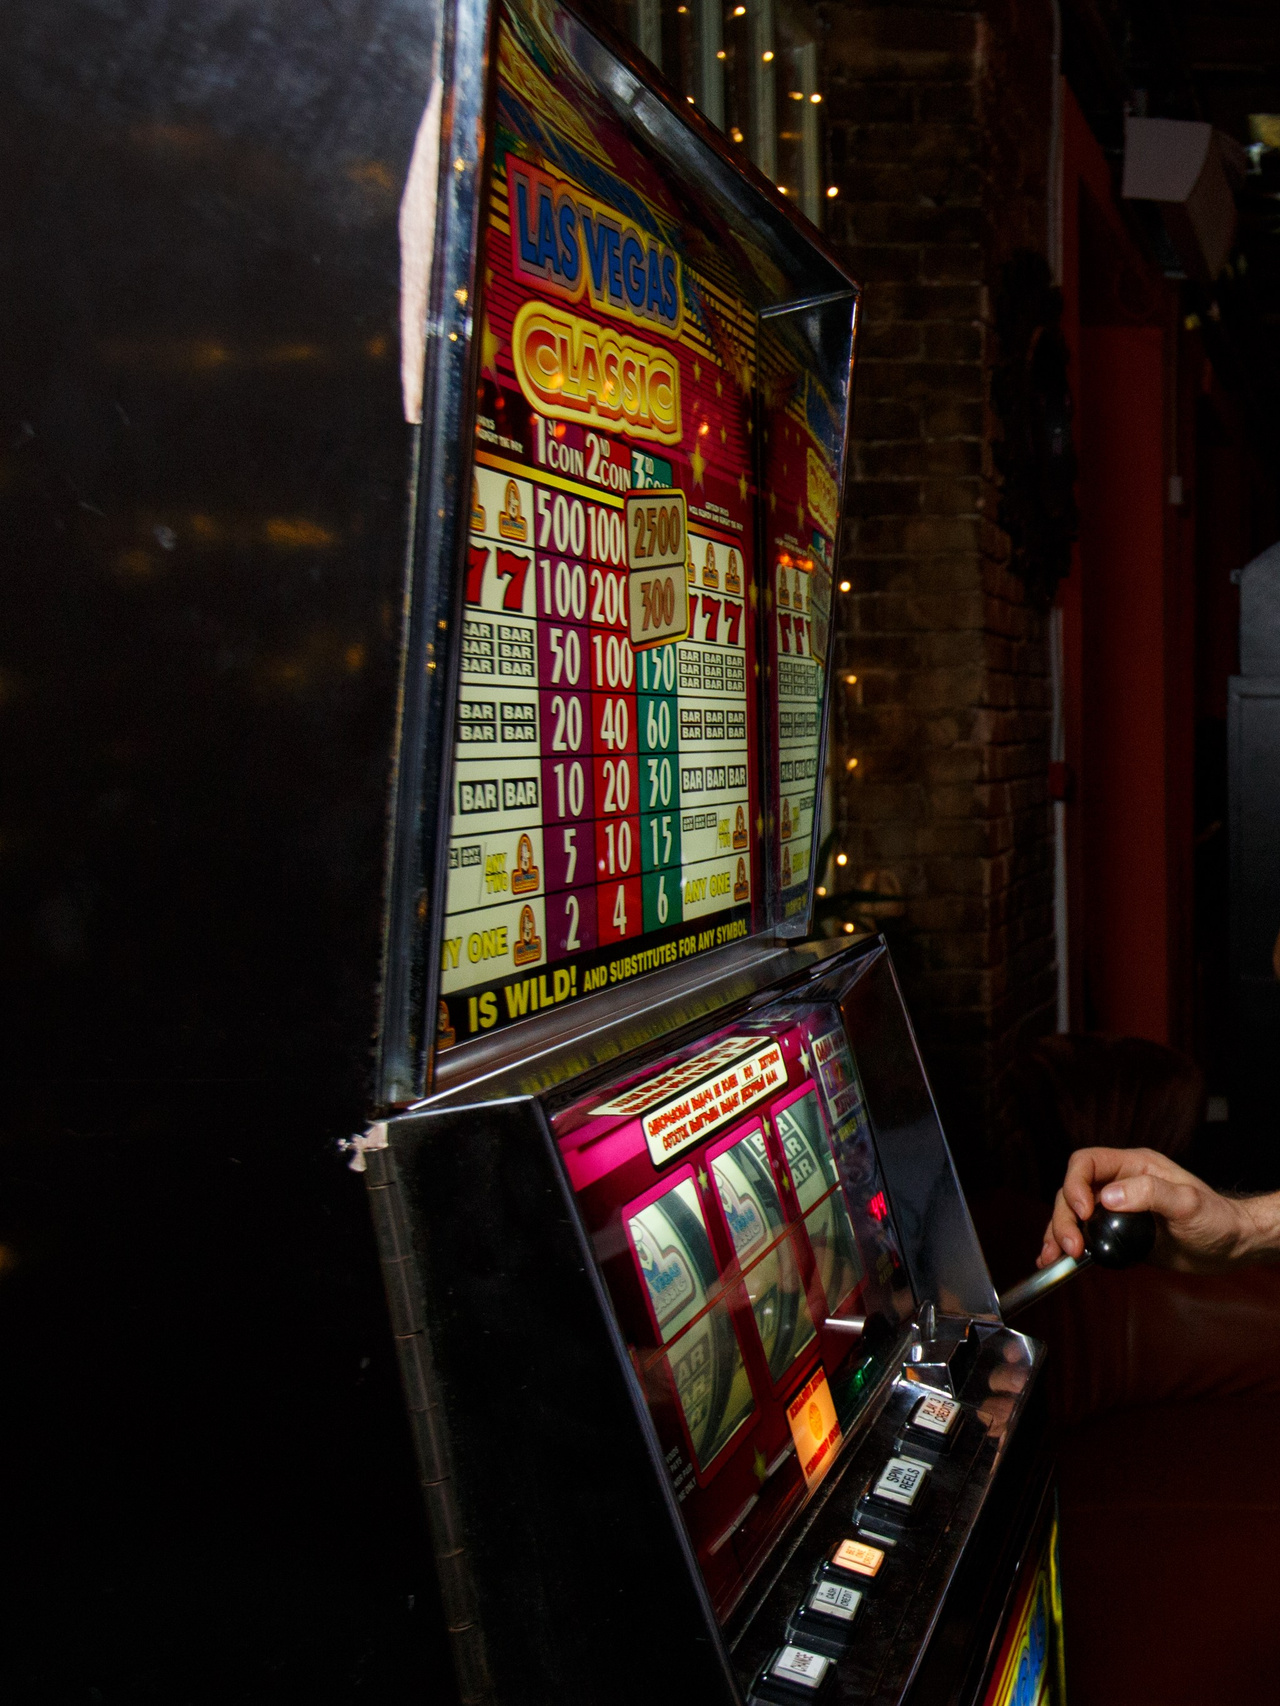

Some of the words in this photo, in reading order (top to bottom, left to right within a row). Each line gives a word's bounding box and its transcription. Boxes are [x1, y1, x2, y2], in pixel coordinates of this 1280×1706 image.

[515, 174, 582, 288] LAS
[579, 206, 680, 326] VEGAS
[523, 325, 677, 428] CLASSIC
[548, 440, 584, 478] COIN
[600, 460, 632, 492] COIN
[537, 488, 586, 556] 500
[634, 506, 681, 558] 2500
[496, 545, 532, 613] 7
[540, 558, 587, 620] 100
[500, 626, 531, 642] BAR
[702, 593, 722, 643] 7
[724, 599, 743, 645] 7
[501, 644, 532, 659] BAR
[550, 628, 580, 685] 50
[592, 635, 634, 689] 100
[642, 644, 675, 692] 150
[680, 650, 700, 662] BAR
[704, 651, 722, 665] BAR
[726, 655, 743, 667] BAR
[502, 661, 533, 676] BAR
[680, 663, 700, 676] BAR
[705, 665, 722, 678] BAR
[726, 668, 743, 680] BAR
[681, 677, 700, 689] BAR
[705, 679, 723, 691] BAR
[727, 681, 743, 692] BAR
[459, 704, 494, 719] BAR
[503, 705, 534, 720] BAR
[551, 695, 582, 751] 20
[601, 698, 628, 750] 40
[647, 700, 671, 749] 60
[681, 711, 701, 722] BAR
[705, 711, 724, 723] BAR
[727, 712, 744, 723] BAR
[461, 725, 495, 741] BAR
[504, 725, 535, 741] BAR
[682, 727, 701, 738] BAR
[706, 727, 724, 738] BAR
[728, 727, 745, 738] BAR
[553, 761, 584, 817] 10
[602, 759, 630, 813] 20
[647, 757, 672, 808] 30
[683, 770, 703, 791] BAR
[706, 768, 725, 788] BAR
[729, 767, 746, 786] BAR
[461, 784, 497, 811] BAR
[505, 781, 537, 807] BAR
[559, 828, 577, 883] 5
[605, 820, 631, 876] 10
[650, 815, 672, 866] 15
[684, 877, 707, 905] ANY
[709, 872, 730, 898] ONE
[565, 895, 581, 951] 2
[613, 884, 627, 935] 4
[657, 875, 669, 924] 6
[468, 926, 508, 963] ONE
[468, 991, 498, 1033] IS
[504, 965, 577, 1018] WILD!
[583, 965, 608, 992] AND
[609, 941, 677, 983] SUBSTITUTES
[678, 934, 697, 958] FOR
[698, 929, 715, 951] ANY
[716, 919, 748, 944] SYMBOL
[935, 1400, 955, 1423] CREDITS
[887, 1466, 904, 1483] SPIN
[899, 1468, 920, 1491] REELS
